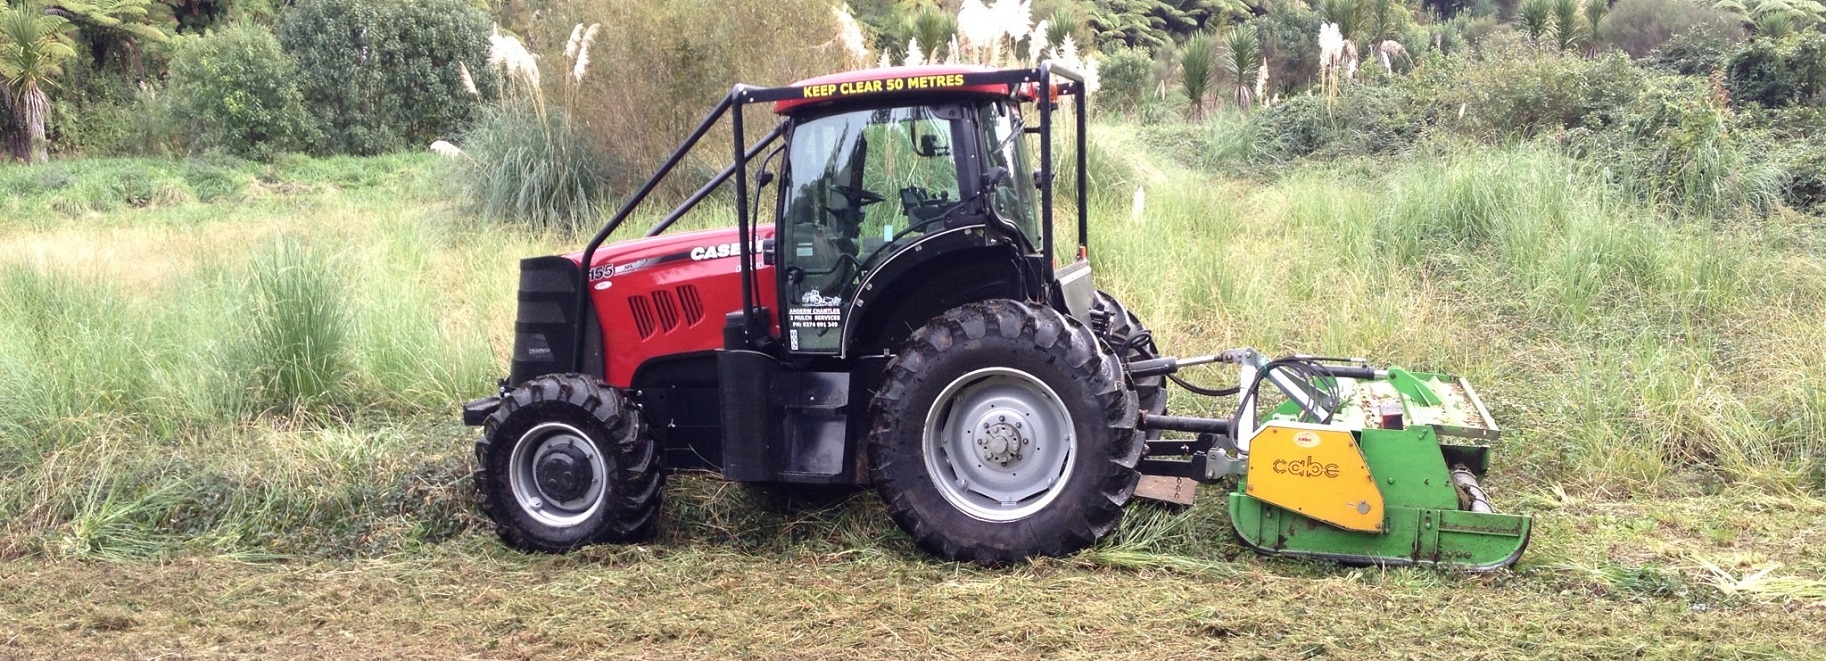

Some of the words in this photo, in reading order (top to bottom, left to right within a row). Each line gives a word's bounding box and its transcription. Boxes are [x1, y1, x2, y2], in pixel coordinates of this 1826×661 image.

[803, 84, 836, 98] KEEP
[840, 80, 883, 95] CLEAR
[886, 78, 903, 91] 50
[908, 74, 964, 89] METRES
[588, 263, 614, 281] 155
[1273, 455, 1340, 479] cabe
